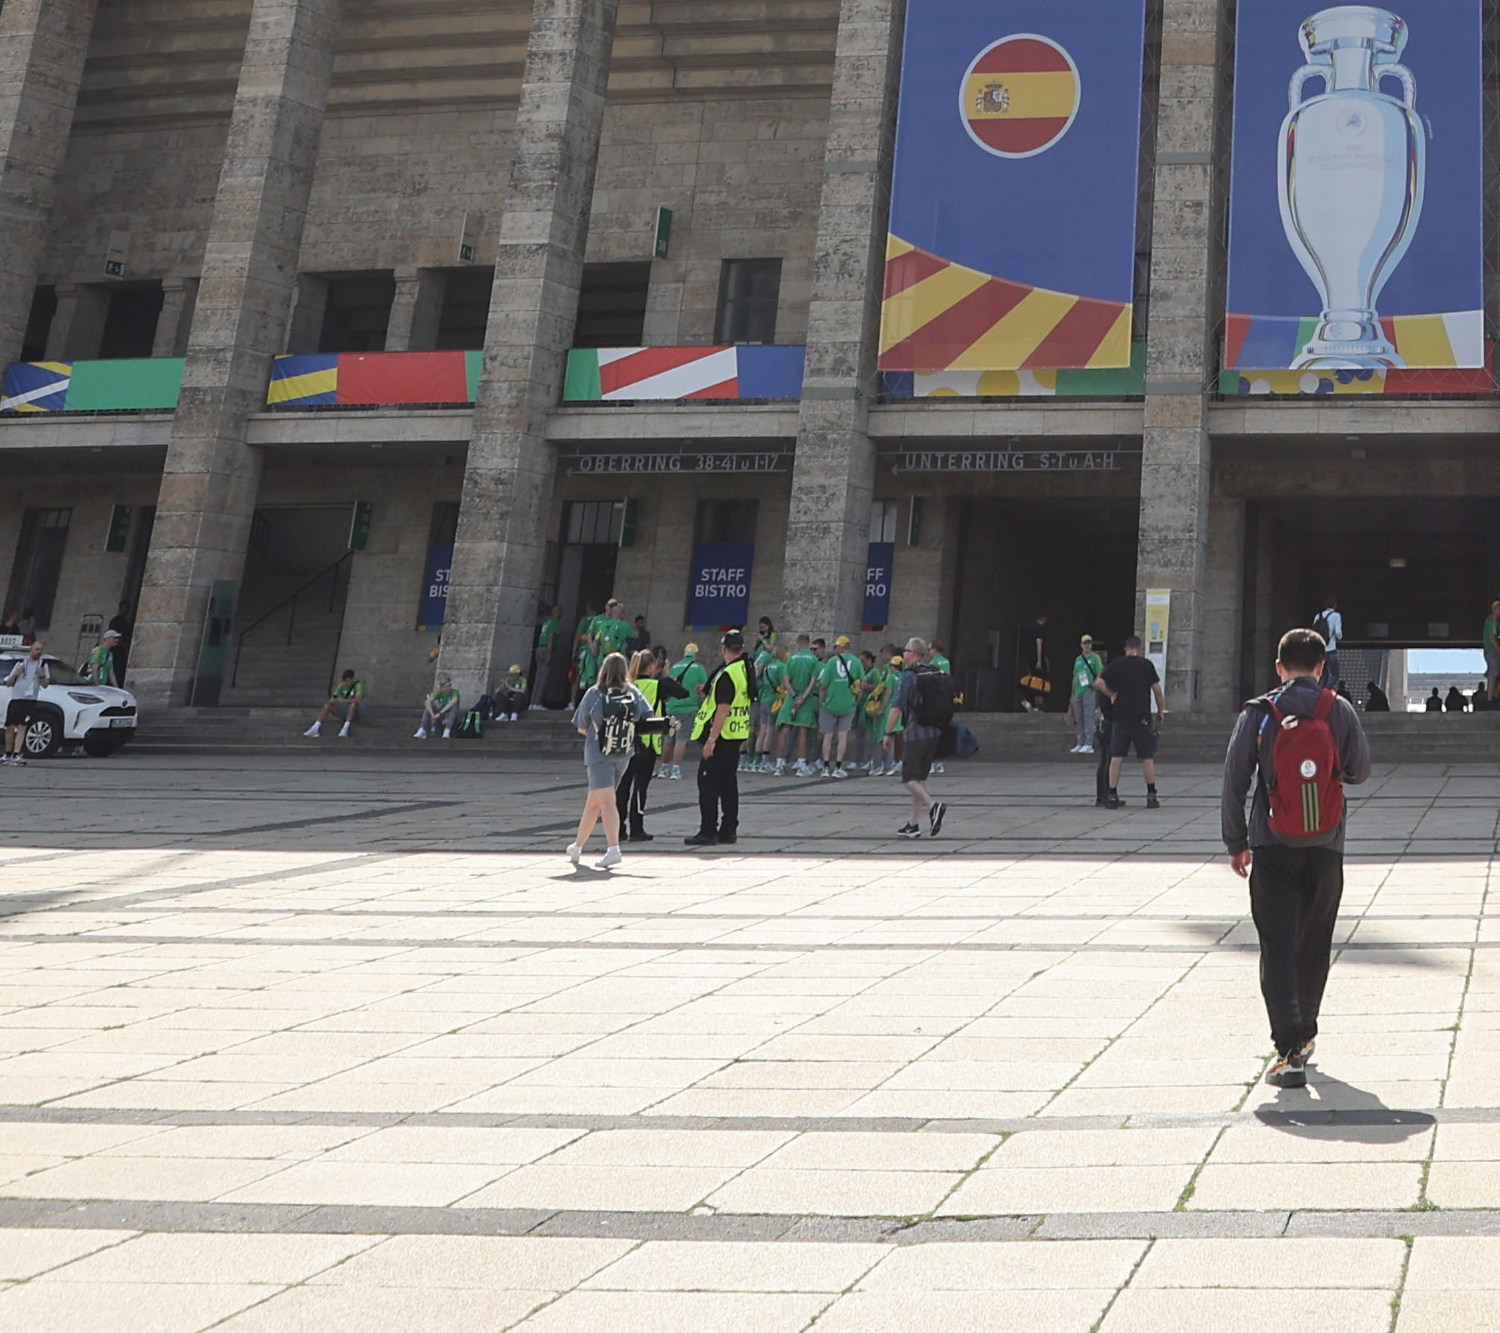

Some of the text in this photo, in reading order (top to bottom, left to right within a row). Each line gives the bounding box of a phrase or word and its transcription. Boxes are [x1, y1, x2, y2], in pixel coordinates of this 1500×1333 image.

[579, 455, 682, 473] OBERRING
[694, 454, 736, 471] 38-41
[754, 454, 780, 470] 1-17
[904, 453, 1025, 470] UNTERRING
[700, 567, 745, 583] STAFF
[694, 583, 747, 598] BISTRO
